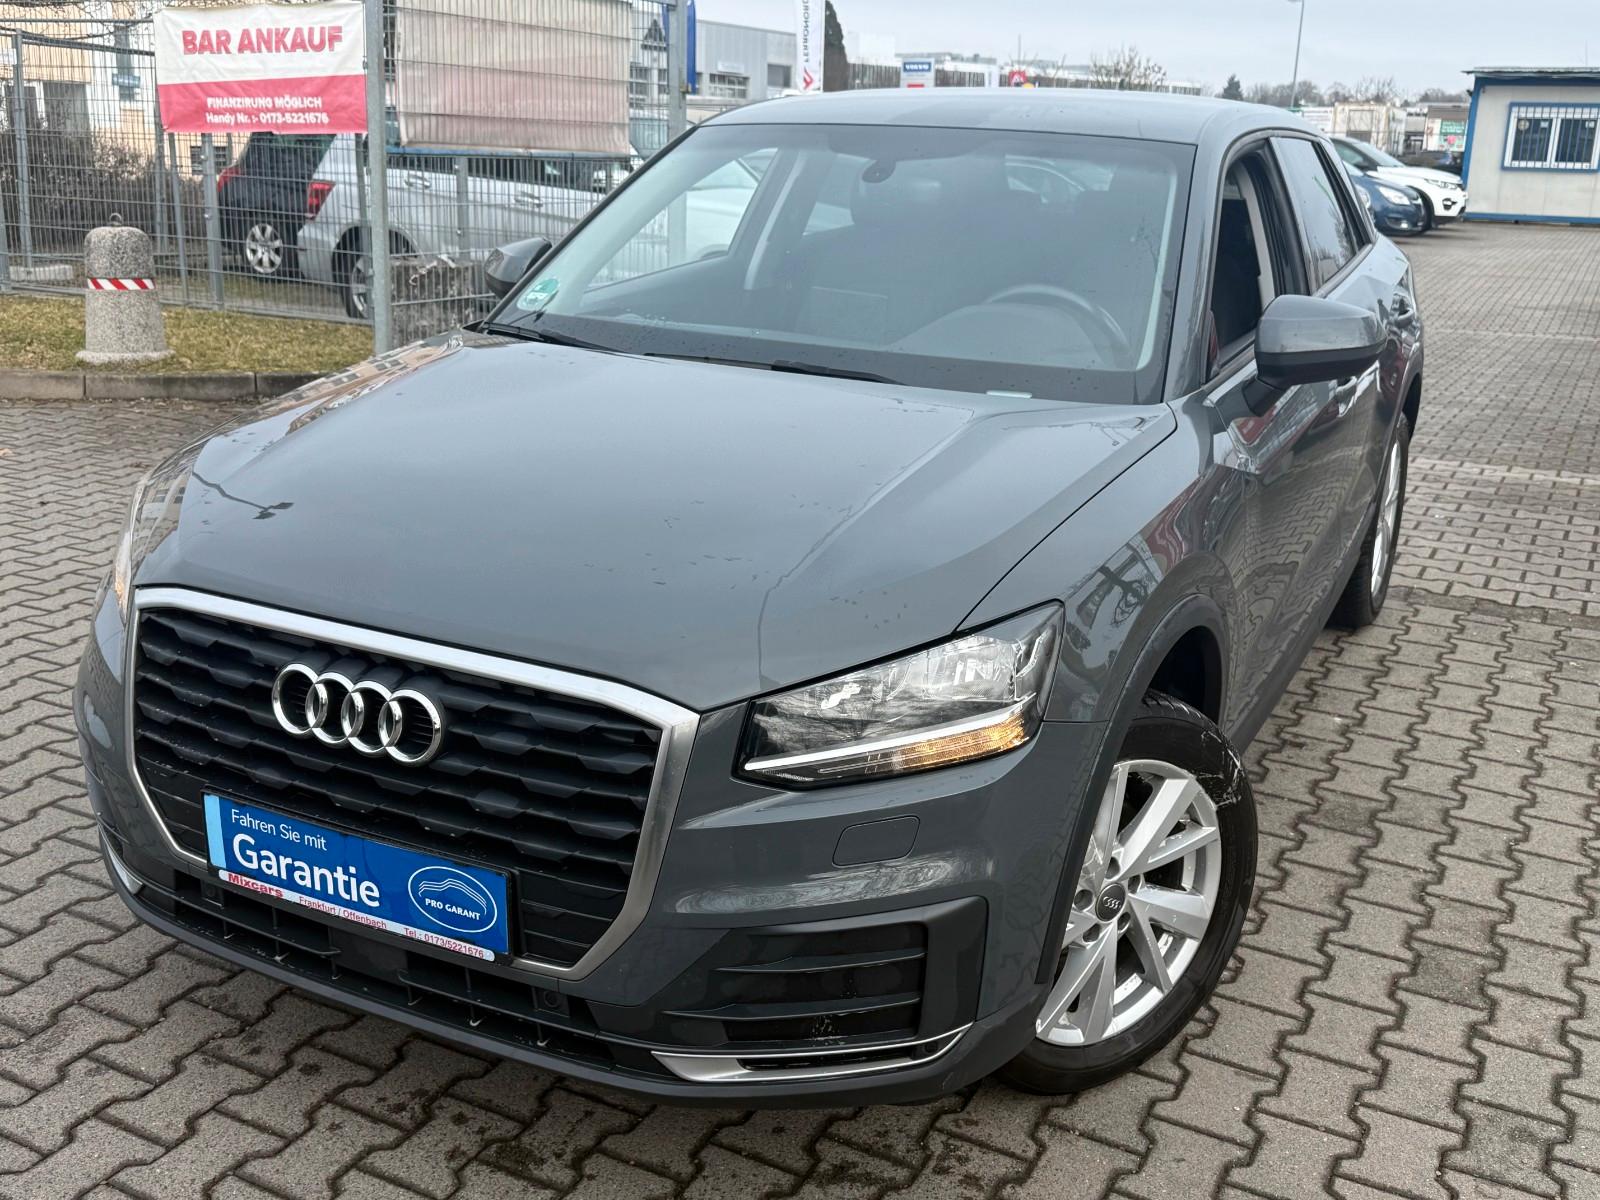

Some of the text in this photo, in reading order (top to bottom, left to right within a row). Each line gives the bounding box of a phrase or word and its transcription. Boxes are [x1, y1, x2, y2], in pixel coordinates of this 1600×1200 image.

[182, 25, 343, 55] BAR ANKAUF
[206, 94, 323, 109] FINANZIRUNG MÖGLICH
[206, 112, 235, 125] Handy
[236, 112, 251, 123] Nr.
[231, 808, 327, 851] Fahren Sie mit
[232, 833, 380, 907] Garantie
[227, 872, 285, 900] Mixcars
[298, 896, 336, 915] Frankfurt
[343, 908, 387, 930] Offenbach
[424, 933, 484, 958] 0173/5221676
[424, 898, 481, 921] PRO GARANT
